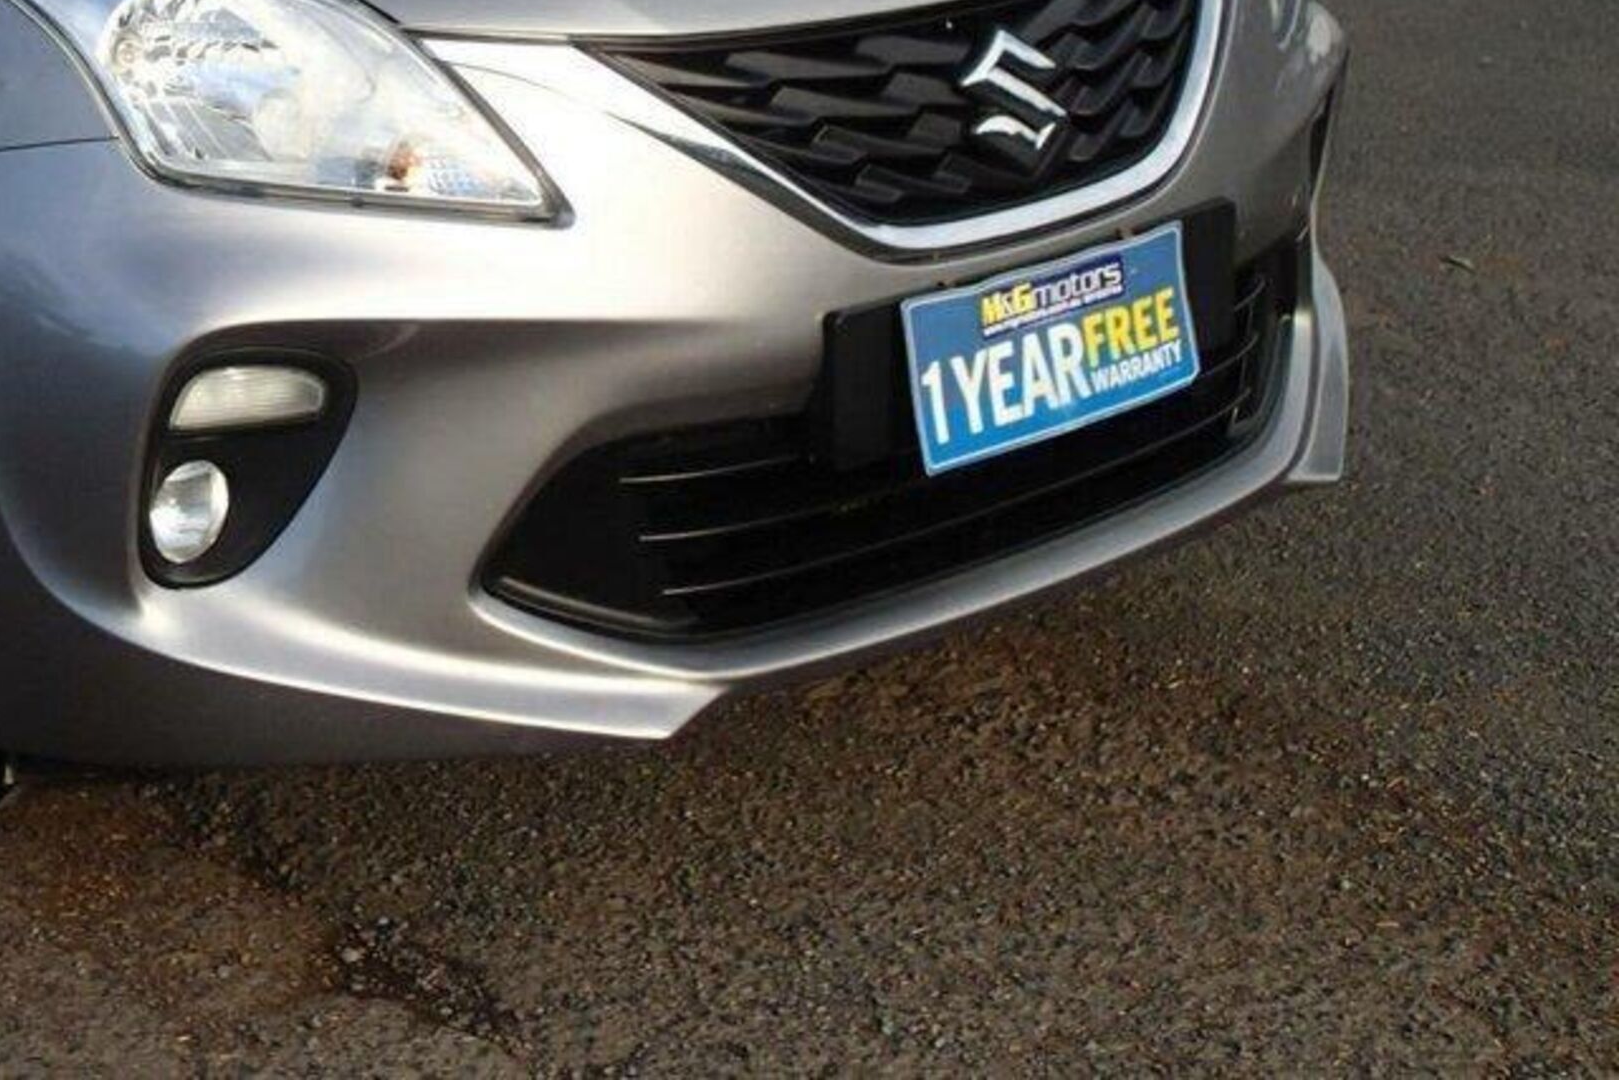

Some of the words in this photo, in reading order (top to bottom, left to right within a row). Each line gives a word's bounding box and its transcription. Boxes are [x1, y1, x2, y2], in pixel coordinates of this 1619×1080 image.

[922, 360, 949, 445] 1
[950, 323, 1093, 434] YEAR
[1083, 287, 1179, 368] FREE
[1090, 338, 1182, 394] WARRANTY
